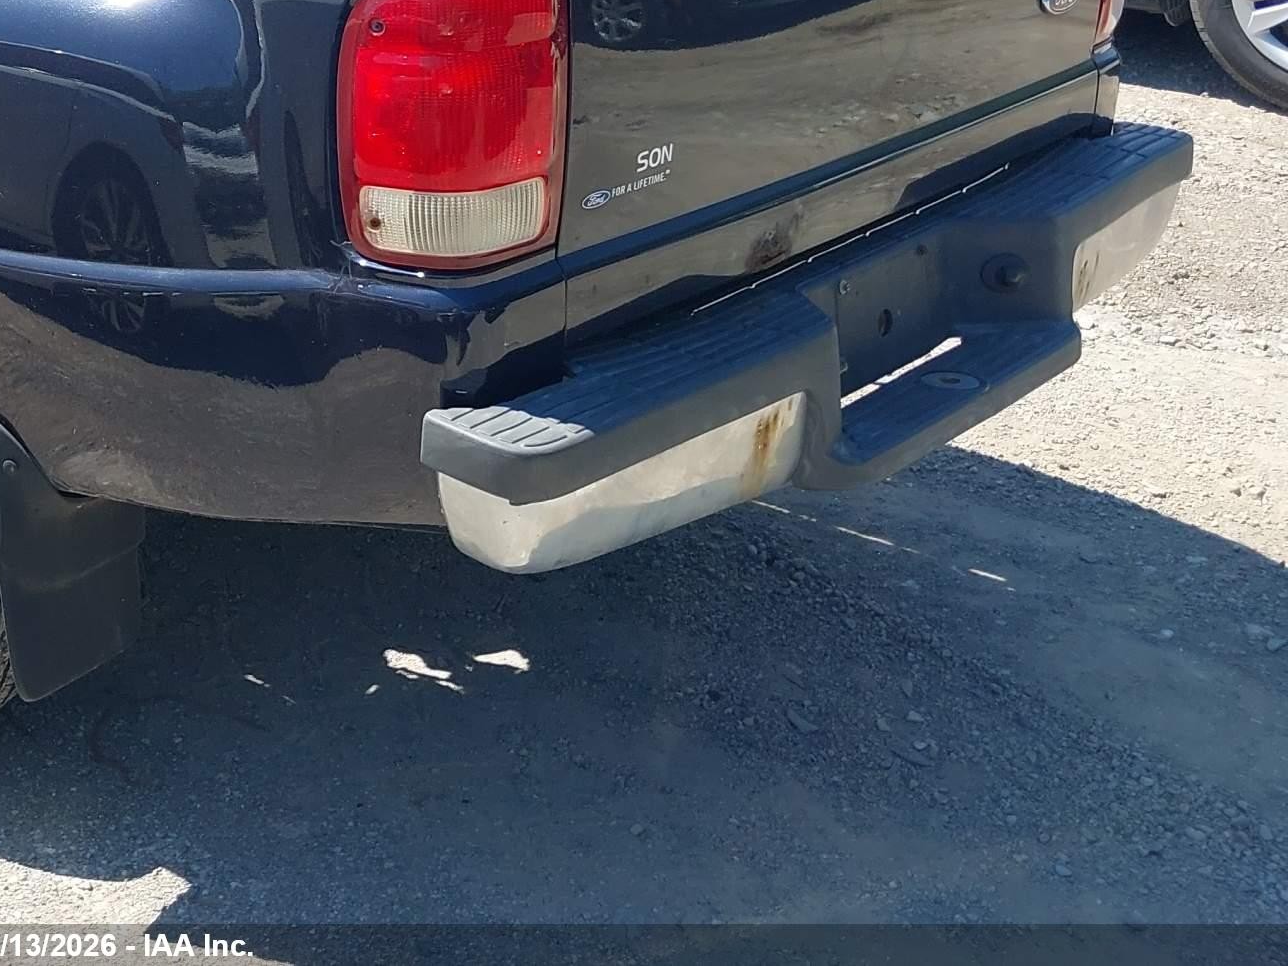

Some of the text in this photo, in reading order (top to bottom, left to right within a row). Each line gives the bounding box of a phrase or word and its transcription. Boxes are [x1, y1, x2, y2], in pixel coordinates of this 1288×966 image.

[636, 142, 674, 173] SON
[611, 185, 626, 198] FOR
[626, 183, 632, 193] A
